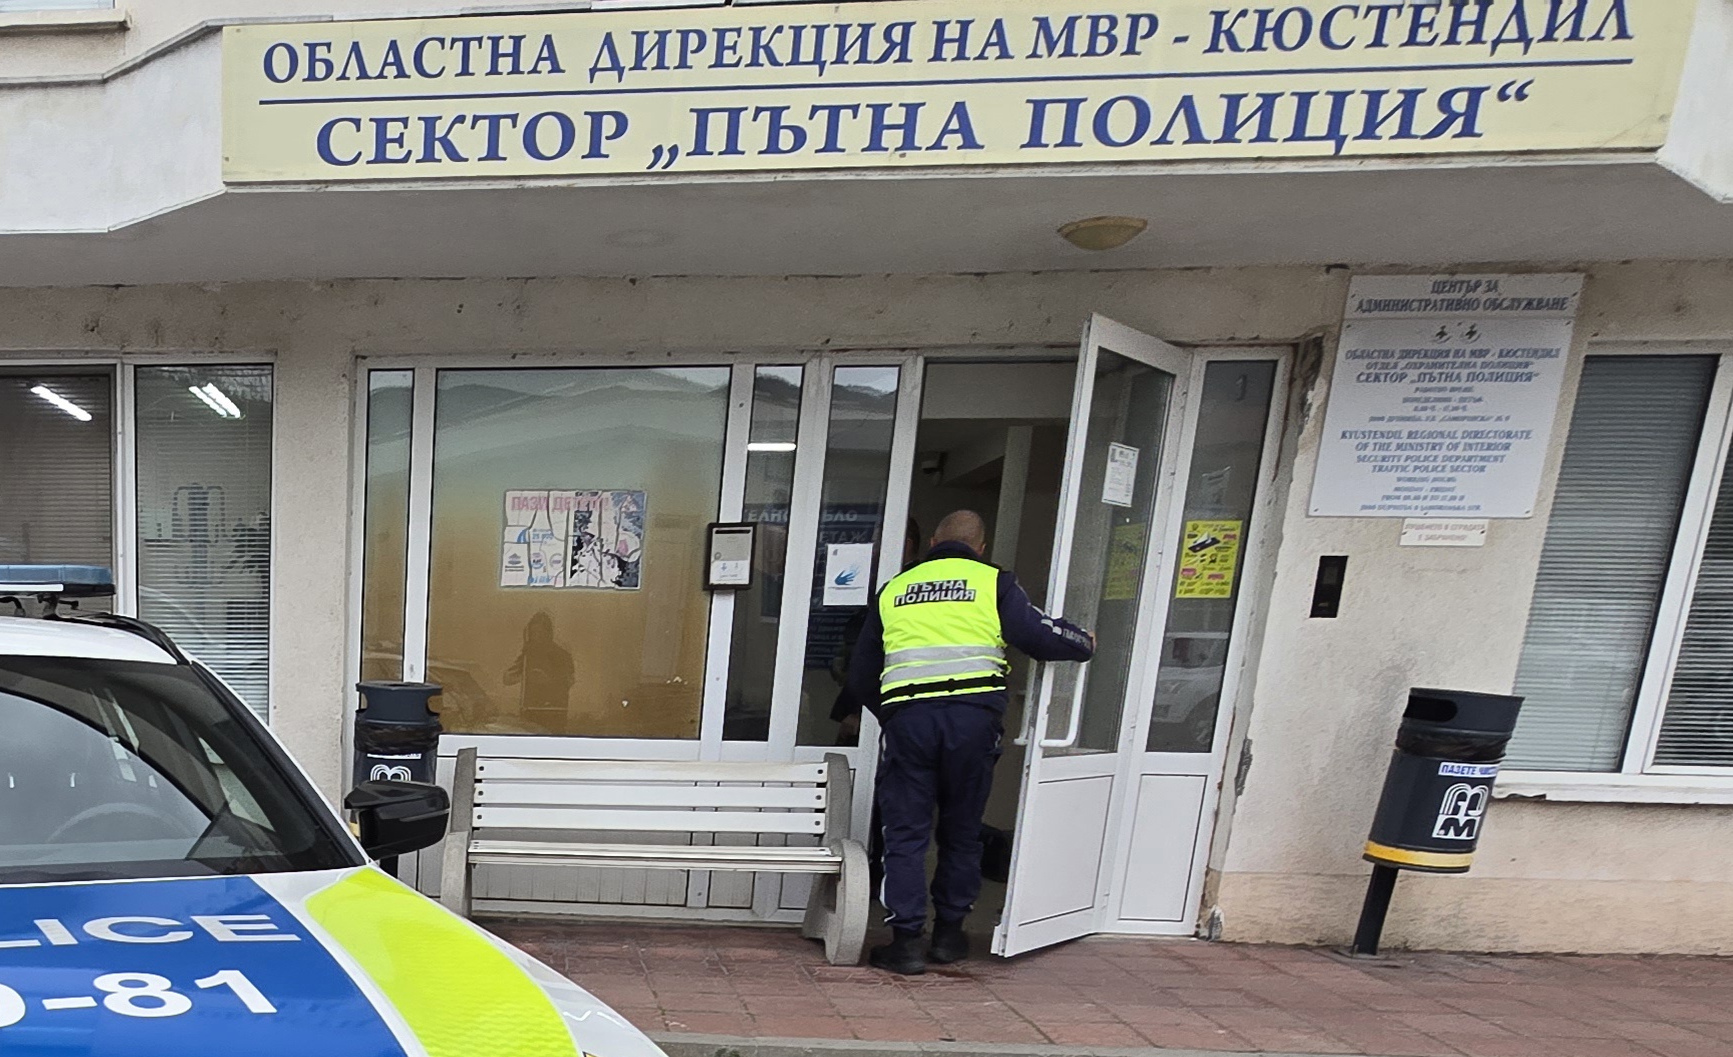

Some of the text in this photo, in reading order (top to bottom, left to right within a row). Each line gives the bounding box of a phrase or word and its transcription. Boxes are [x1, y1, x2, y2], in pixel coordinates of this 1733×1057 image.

[262, 34, 565, 83] ОБЛАСТНА
[589, 20, 916, 83] ДИРЕКЦИЯ
[927, 19, 1015, 62] НА
[1027, 14, 1160, 61] МВР
[1202, 0, 1634, 57] КЮСТЕНДИЛ
[316, 110, 630, 166] СЕКТОР
[1356, 372, 1408, 383] СЕКТОР
[907, 580, 966, 592] ПЪТНА
[895, 590, 976, 606] ПОЛИЦИЯ
[1441, 764, 1477, 775] ПАЗЕТЕ
